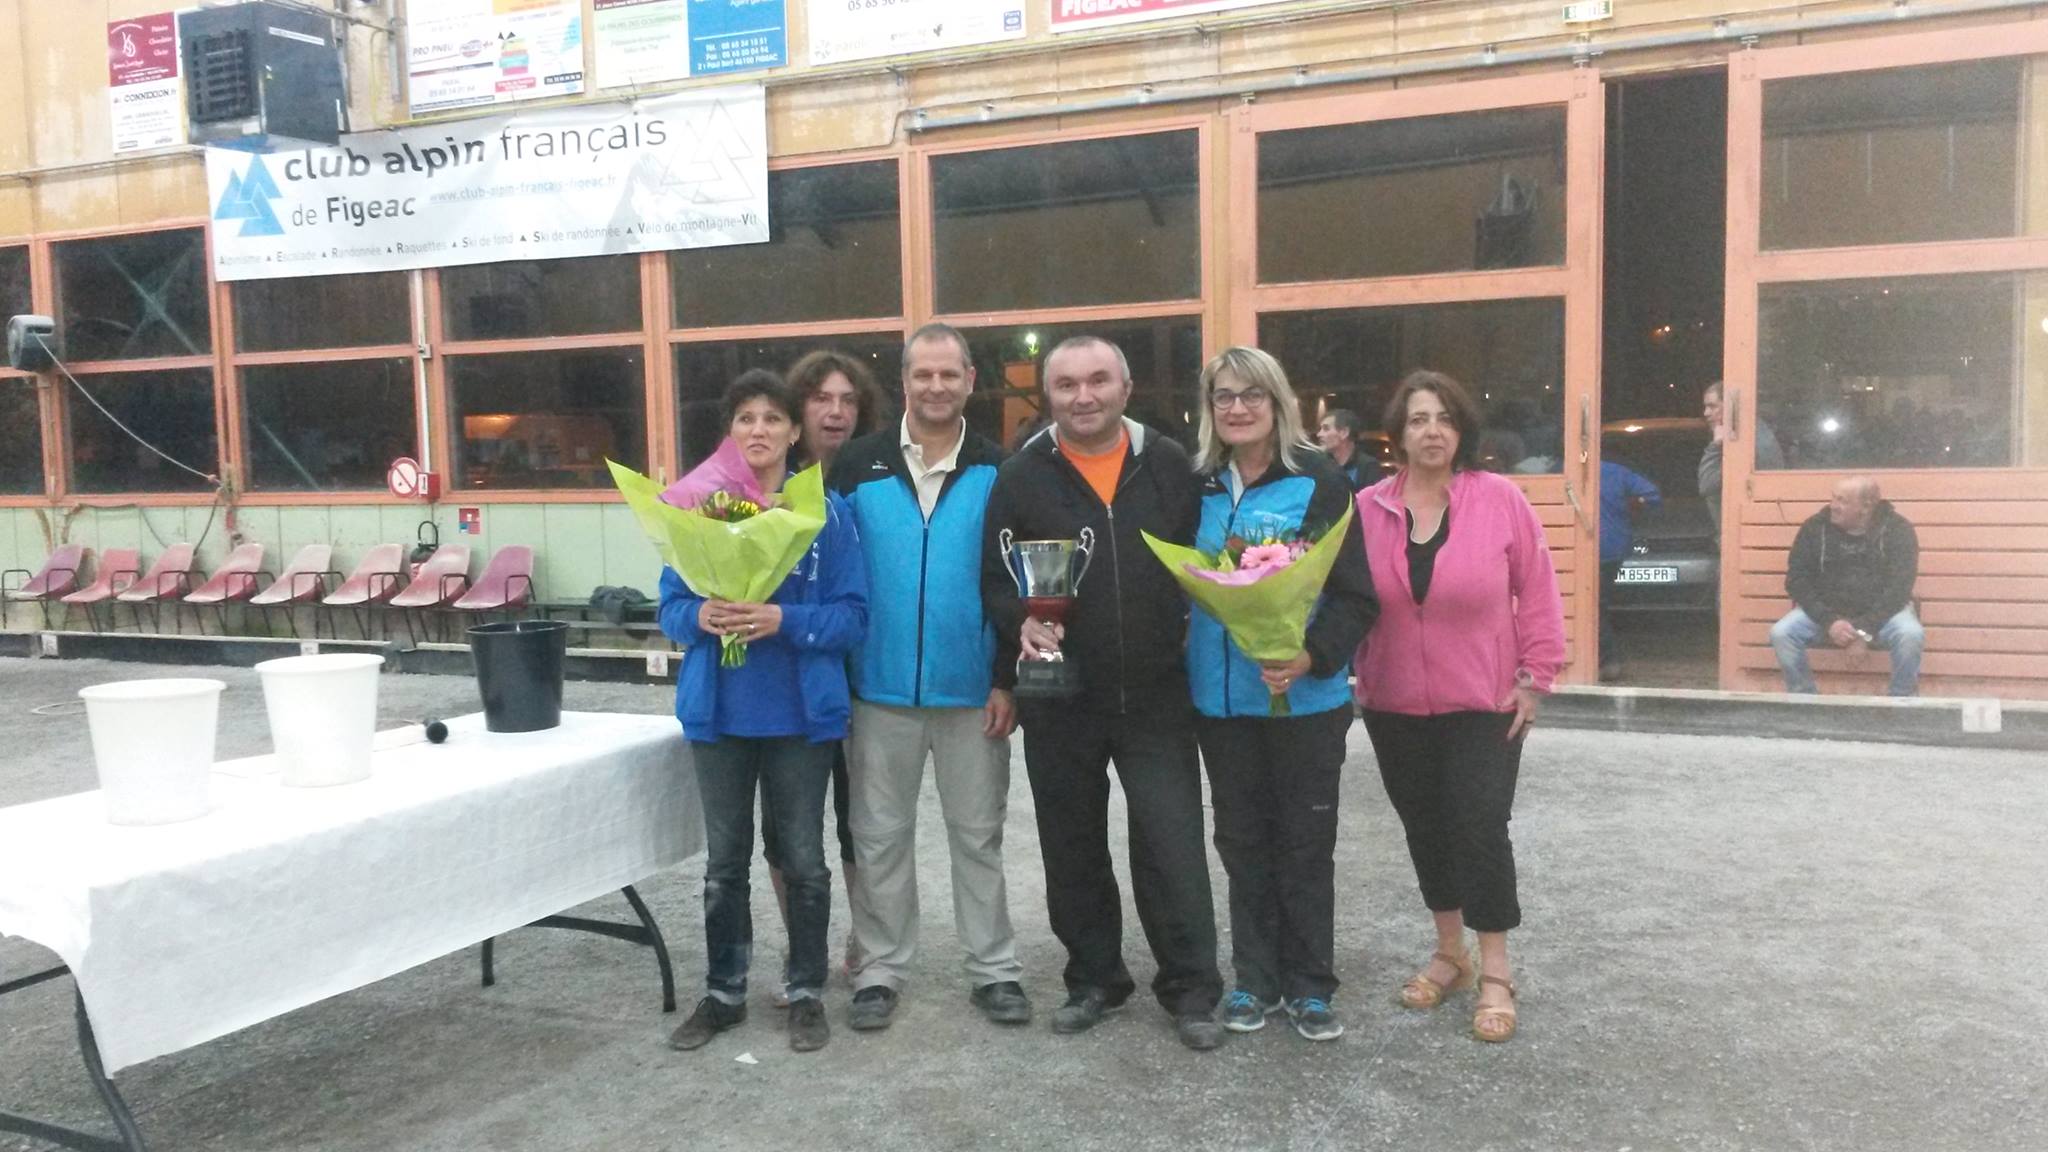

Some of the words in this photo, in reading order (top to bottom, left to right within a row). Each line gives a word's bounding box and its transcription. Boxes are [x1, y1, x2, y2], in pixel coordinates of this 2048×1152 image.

[1568, 2, 1606, 18] STIE
[284, 148, 371, 181] club
[383, 136, 486, 178] alpin
[499, 119, 668, 162] français
[291, 204, 318, 227] de
[326, 196, 417, 227] Figeac
[396, 240, 447, 256] Raquettes
[533, 231, 549, 243] Ski
[551, 229, 564, 241] de
[664, 219, 677, 231] de
[1628, 569, 1651, 581] 855
